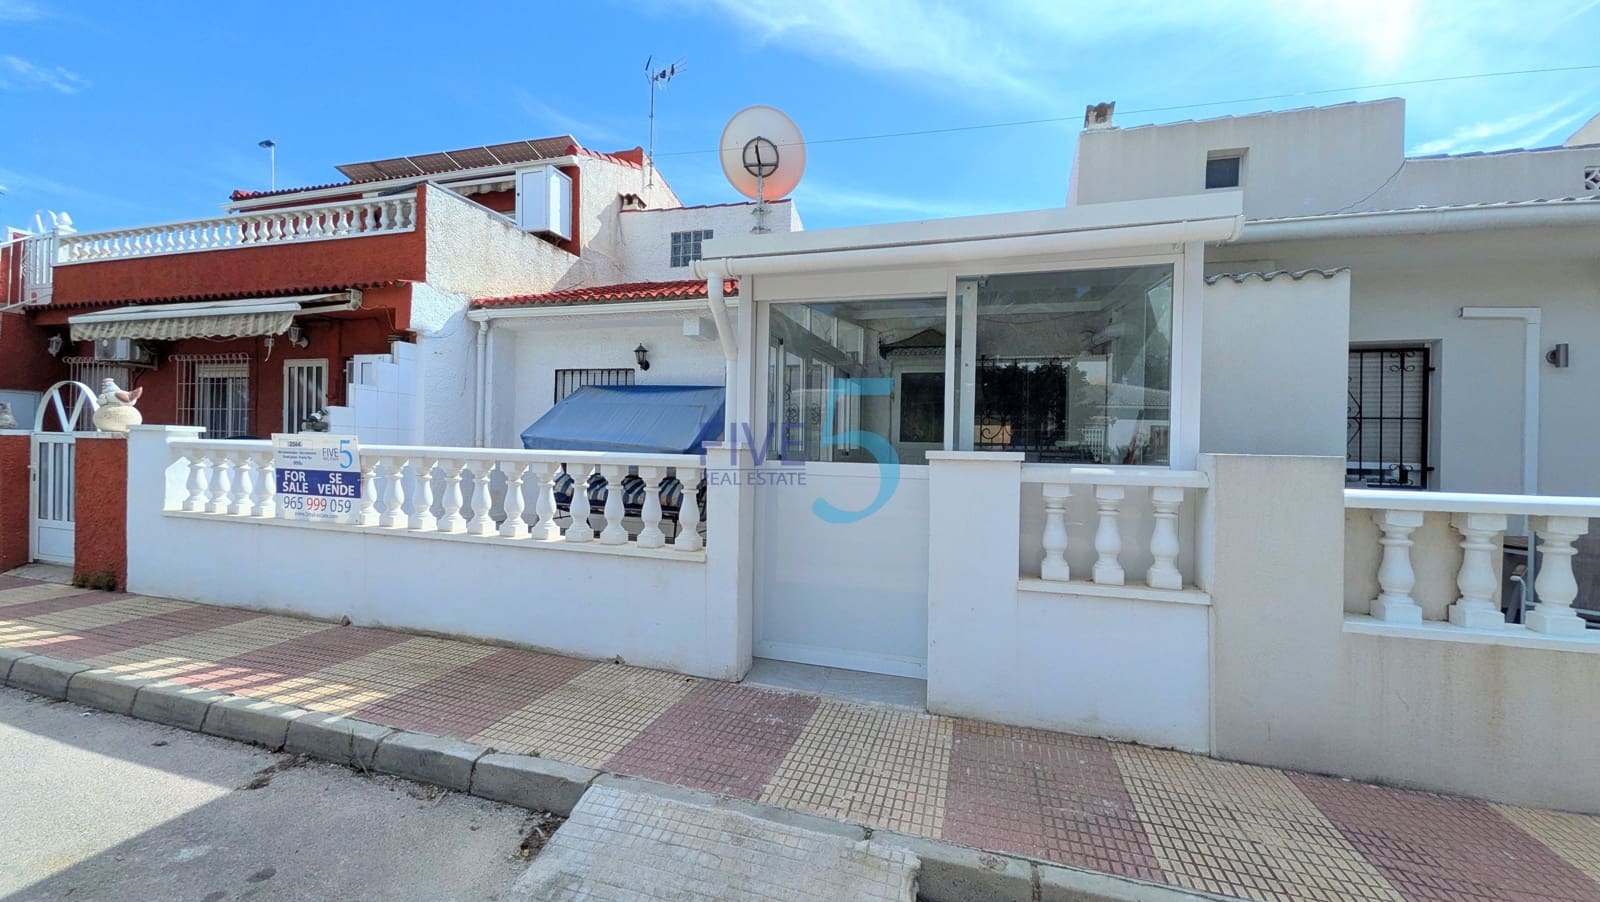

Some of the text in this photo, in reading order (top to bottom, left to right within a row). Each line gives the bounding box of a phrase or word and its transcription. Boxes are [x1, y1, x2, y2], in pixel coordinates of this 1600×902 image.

[322, 440, 353, 469] FIVE 5
[284, 471, 306, 482] FOR
[329, 473, 343, 484] SE
[282, 482, 309, 493] SALE
[317, 483, 355, 496] VENDE
[283, 496, 352, 513] 965 999 059
